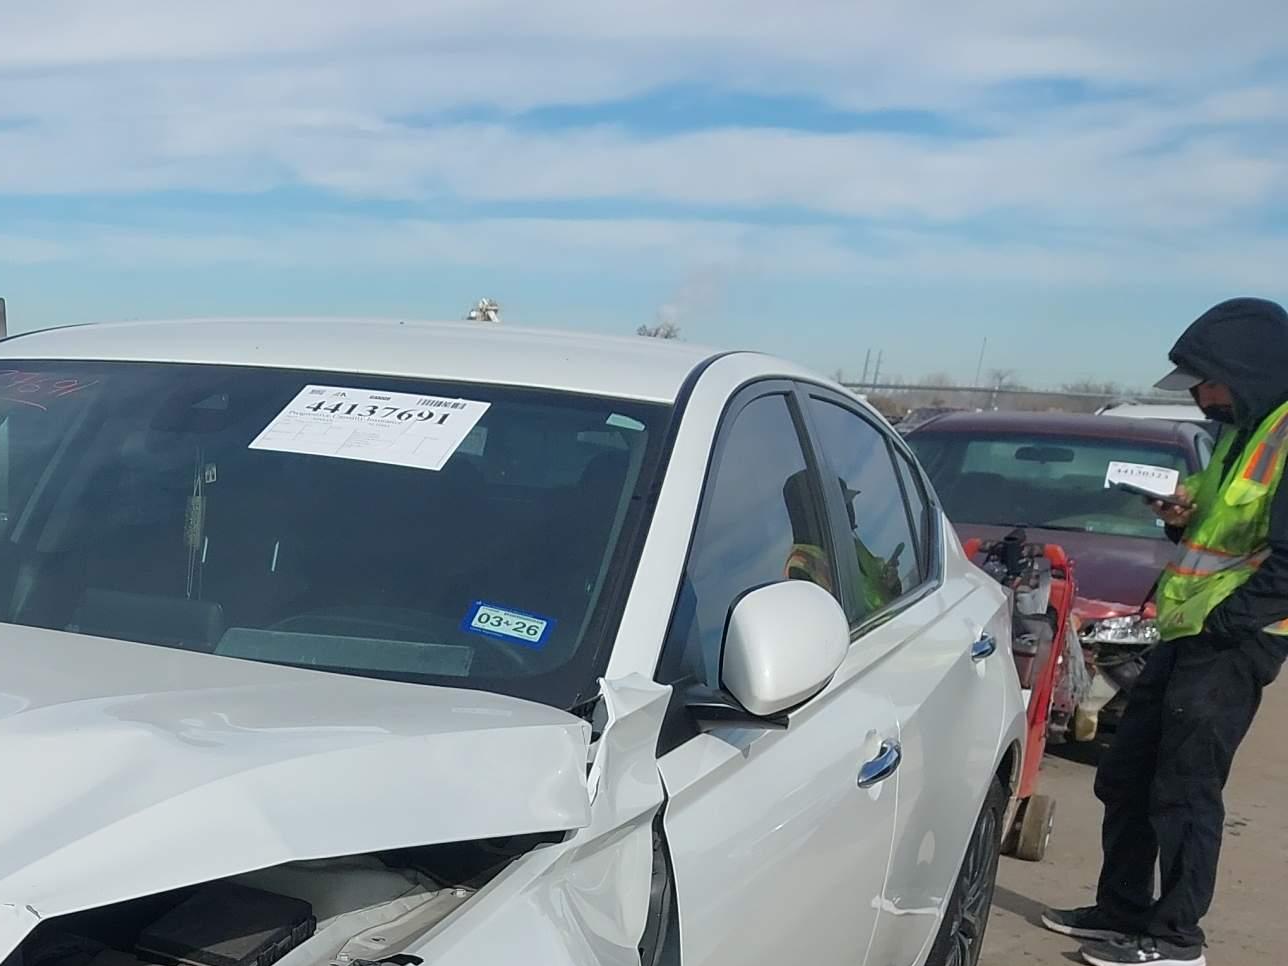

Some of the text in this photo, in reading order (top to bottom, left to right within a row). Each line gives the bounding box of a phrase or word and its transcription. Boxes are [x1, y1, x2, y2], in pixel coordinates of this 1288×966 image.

[306, 400, 450, 425] 44137691
[477, 612, 503, 627] 03
[511, 621, 540, 636] 26
